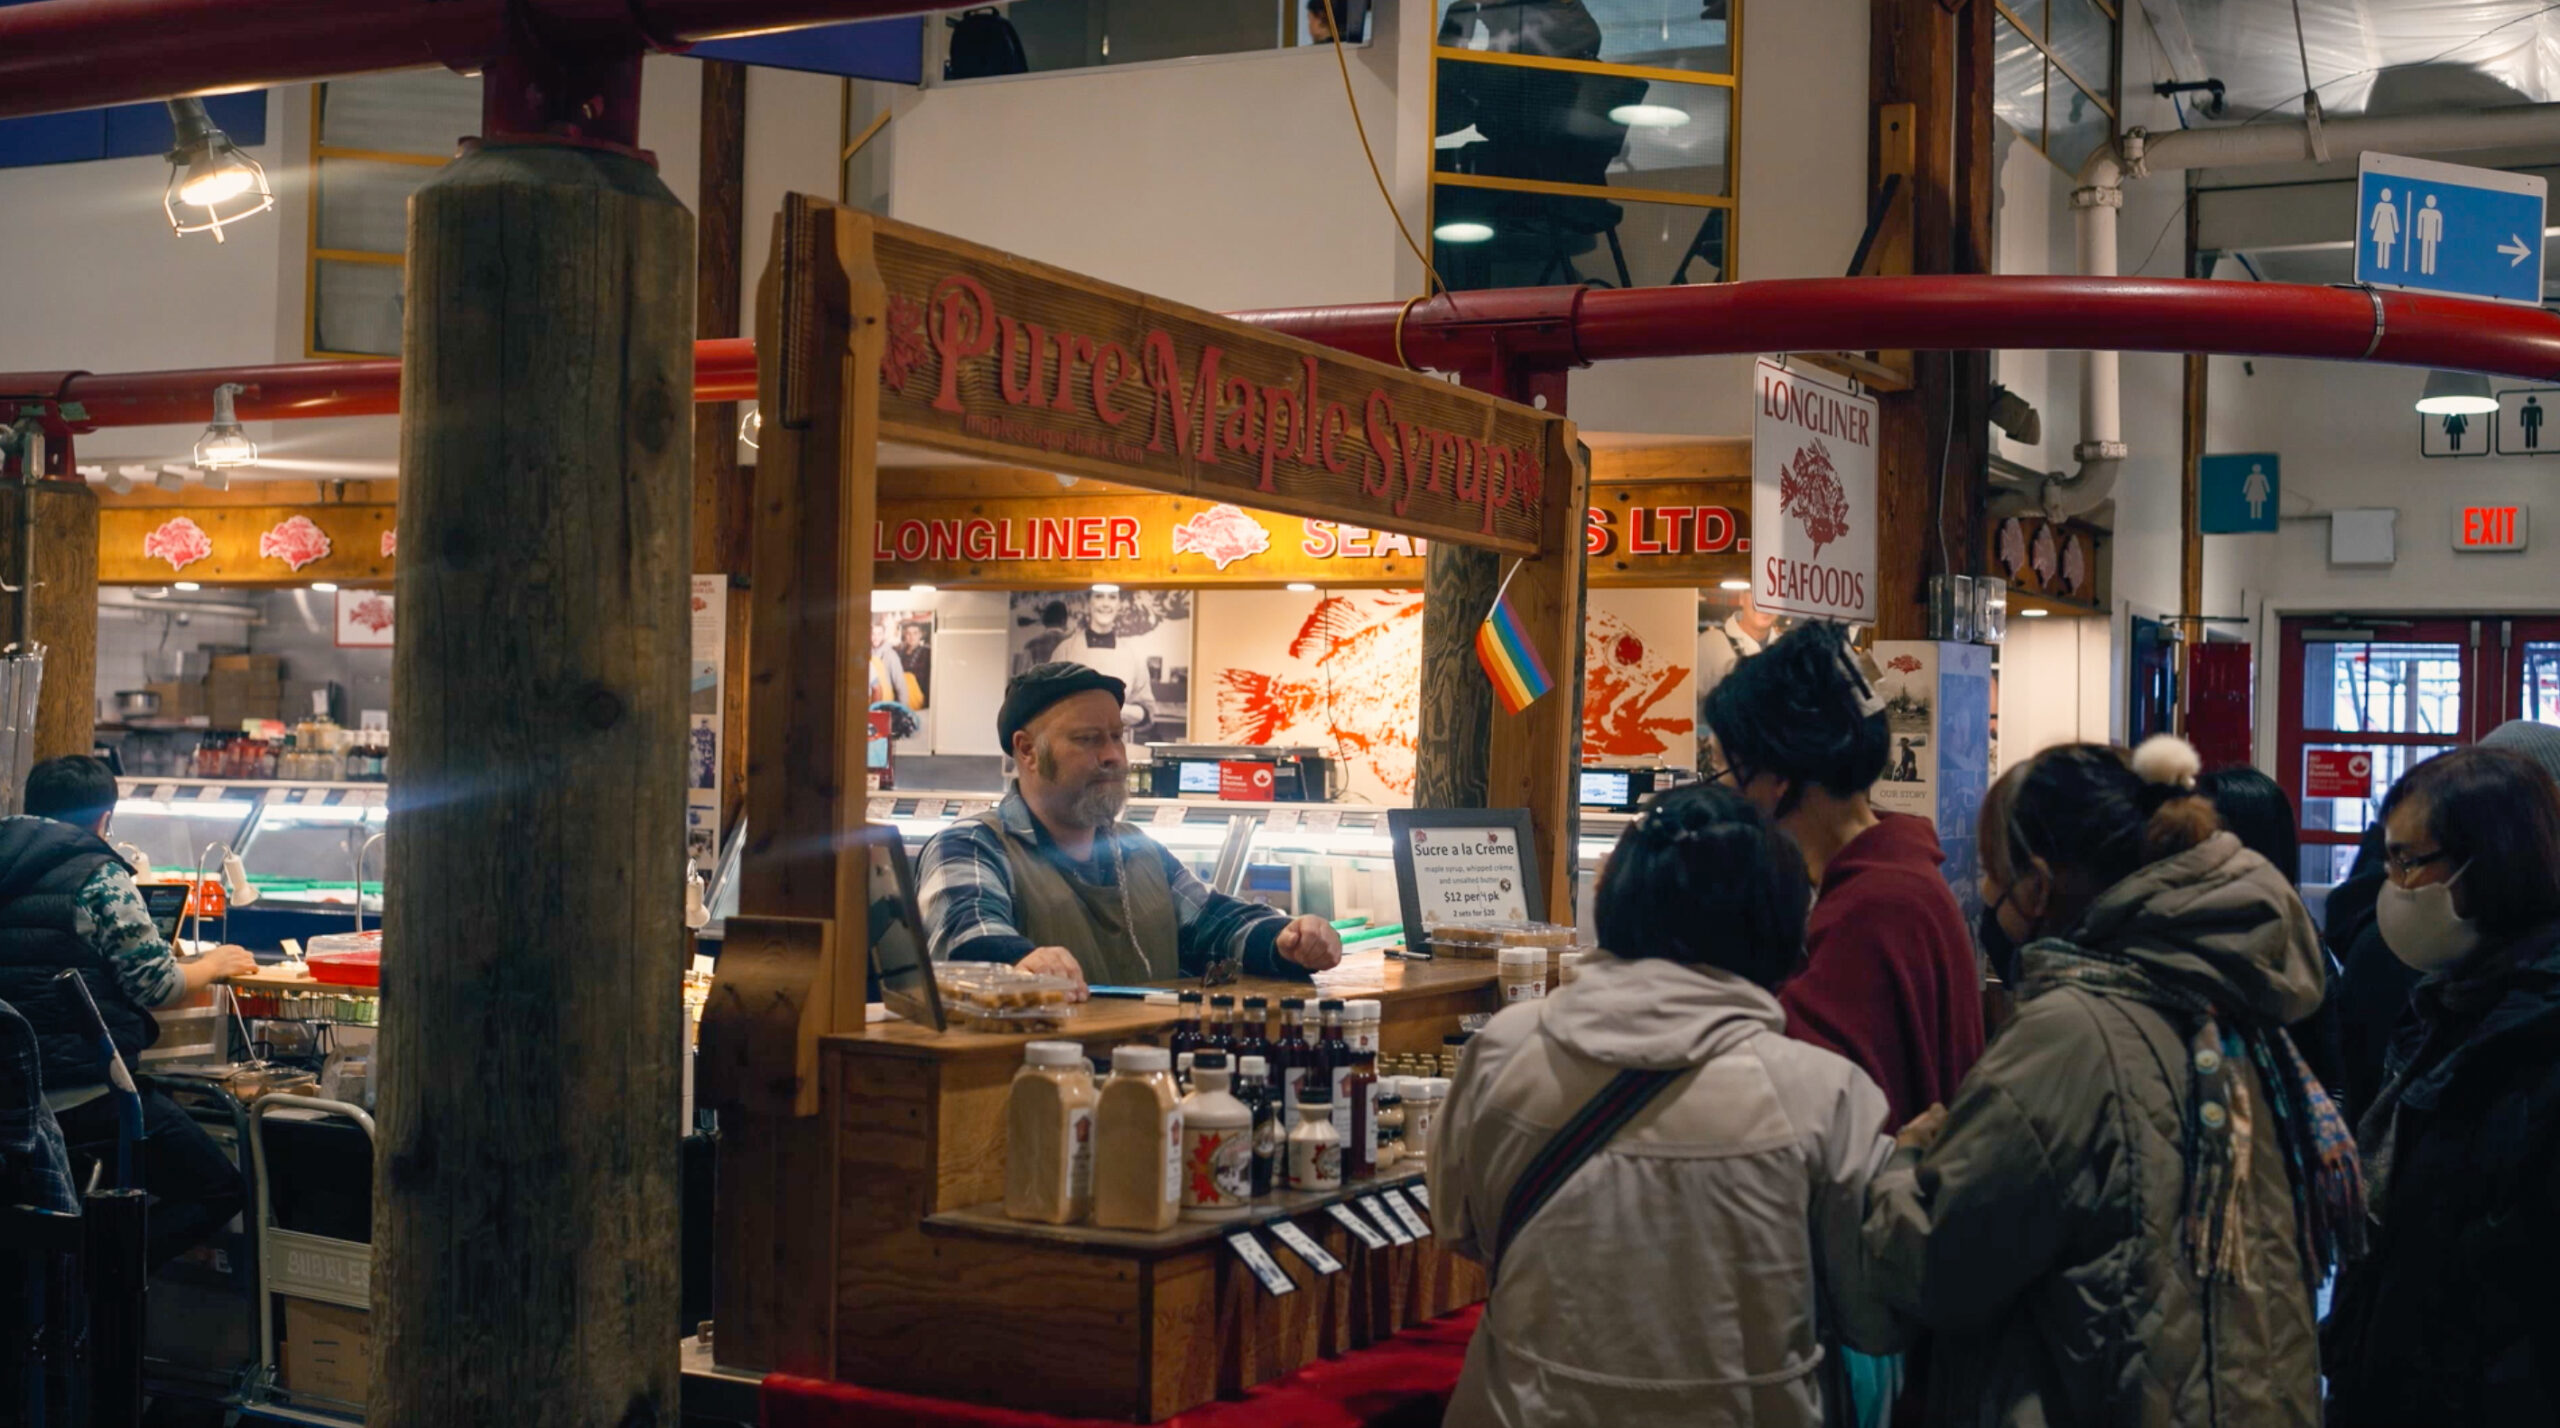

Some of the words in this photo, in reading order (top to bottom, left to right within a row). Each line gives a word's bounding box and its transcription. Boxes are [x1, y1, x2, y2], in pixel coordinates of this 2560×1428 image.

[927, 275, 1131, 425] Pure
[1143, 330, 1350, 492] Maple
[1363, 388, 1513, 536] Syrup
[1764, 376, 1870, 447] LONGLINER
[2464, 506, 2519, 545] EXIT
[873, 516, 1141, 562] LONGLINER
[1630, 505, 1751, 554] LTD.
[1766, 556, 1865, 610] SEAFOODS
[1880, 790, 1898, 798] OUR
[1900, 790, 1927, 799] STORY
[1414, 843, 1448, 856] Sucre
[1451, 846, 1459, 856] a
[1461, 843, 1473, 855] la
[1466, 864, 1493, 873] whipped
[1439, 876, 1451, 884] and
[1452, 876, 1479, 884] unsalted
[1444, 891, 1462, 903] $12
[1464, 893, 1480, 903] per
[1488, 891, 1500, 903] pk
[1472, 909, 1482, 917] for
